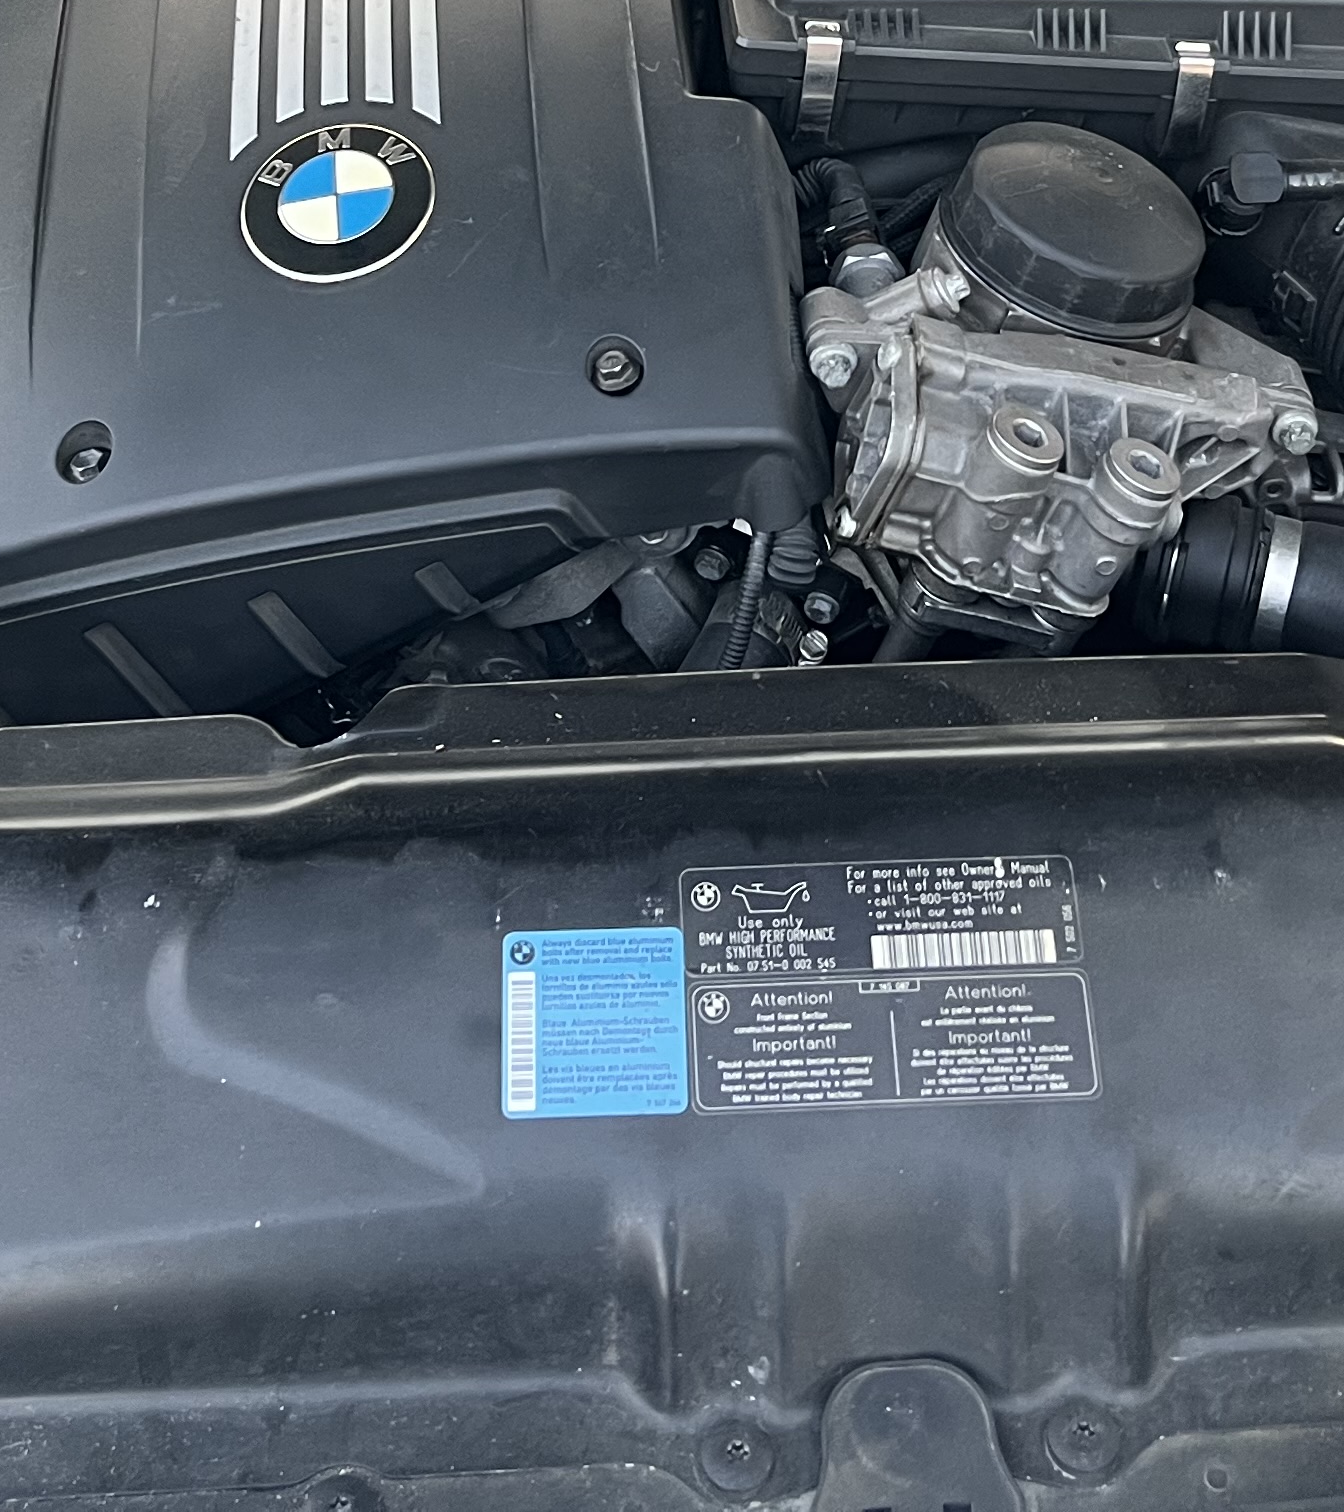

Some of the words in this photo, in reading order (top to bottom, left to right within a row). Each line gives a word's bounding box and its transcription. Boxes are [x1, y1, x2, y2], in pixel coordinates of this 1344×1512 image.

[257, 128, 416, 186] BMW
[846, 866, 866, 880] For
[873, 868, 900, 879] more
[907, 864, 929, 878] info
[937, 866, 955, 877] see
[1010, 860, 1050, 875] Manual
[847, 880, 866, 894] For
[874, 883, 880, 893] a
[888, 879, 908, 892] list
[915, 880, 928, 891] of
[935, 878, 964, 891] other
[972, 876, 1023, 890] approved
[1029, 875, 1051, 887] oils
[874, 894, 896, 906] call
[904, 891, 1006, 905] 1-800-831-1117
[876, 909, 887, 919] or
[895, 907, 921, 918] visit
[928, 908, 946, 916] our
[953, 905, 974, 915] web
[981, 904, 1003, 914] site
[1011, 903, 1023, 914] at
[738, 916, 763, 929] Use
[772, 914, 804, 930] only
[877, 919, 974, 931] www.bmwusa.com
[698, 932, 723, 947] BMW
[729, 931, 755, 945] HIGH
[761, 927, 836, 944] PERFORMANCE
[725, 944, 784, 960] SYNTHETIC
[789, 943, 808, 957] OIL
[701, 963, 721, 973] Part
[750, 990, 833, 1007] Attention!
[945, 983, 1026, 1001] Attention!
[752, 1035, 836, 1054] Important!
[948, 1028, 1031, 1047] Important!
